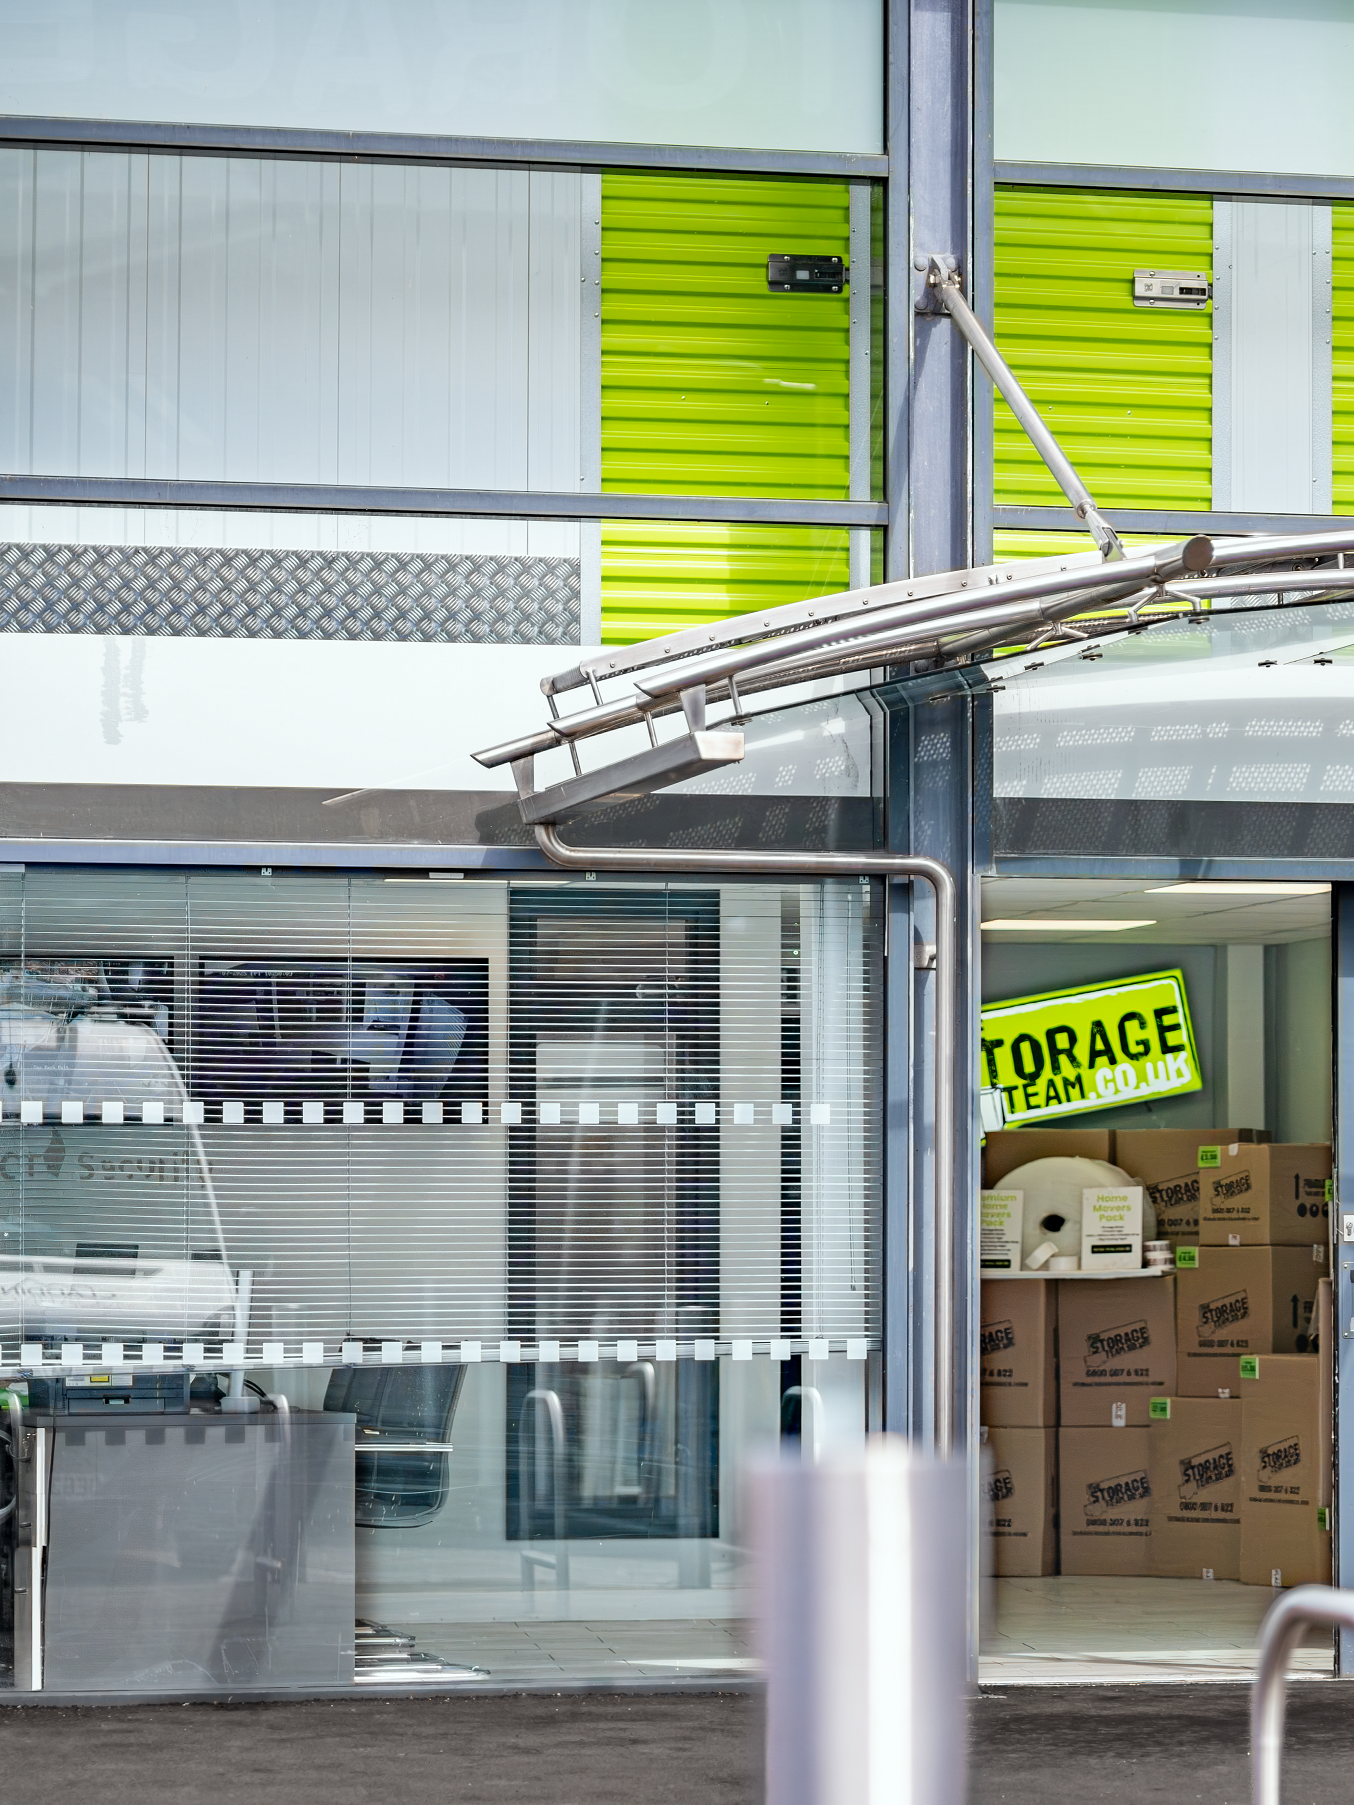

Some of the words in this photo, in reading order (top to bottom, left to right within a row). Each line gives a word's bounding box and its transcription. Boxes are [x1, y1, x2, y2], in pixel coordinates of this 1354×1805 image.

[981, 1005, 1186, 1088] TORAGE
[1096, 1194, 1128, 1203] Home
[1149, 1179, 1199, 1204] STORAG
[1092, 1204, 1132, 1213] Movers
[1098, 1213, 1125, 1222] Pack
[1202, 1296, 1249, 1325] STORAGE
[1090, 1326, 1148, 1354] STORAGE
[1183, 1451, 1233, 1484] STORAGE
[1090, 1476, 1149, 1504] STORAGE
